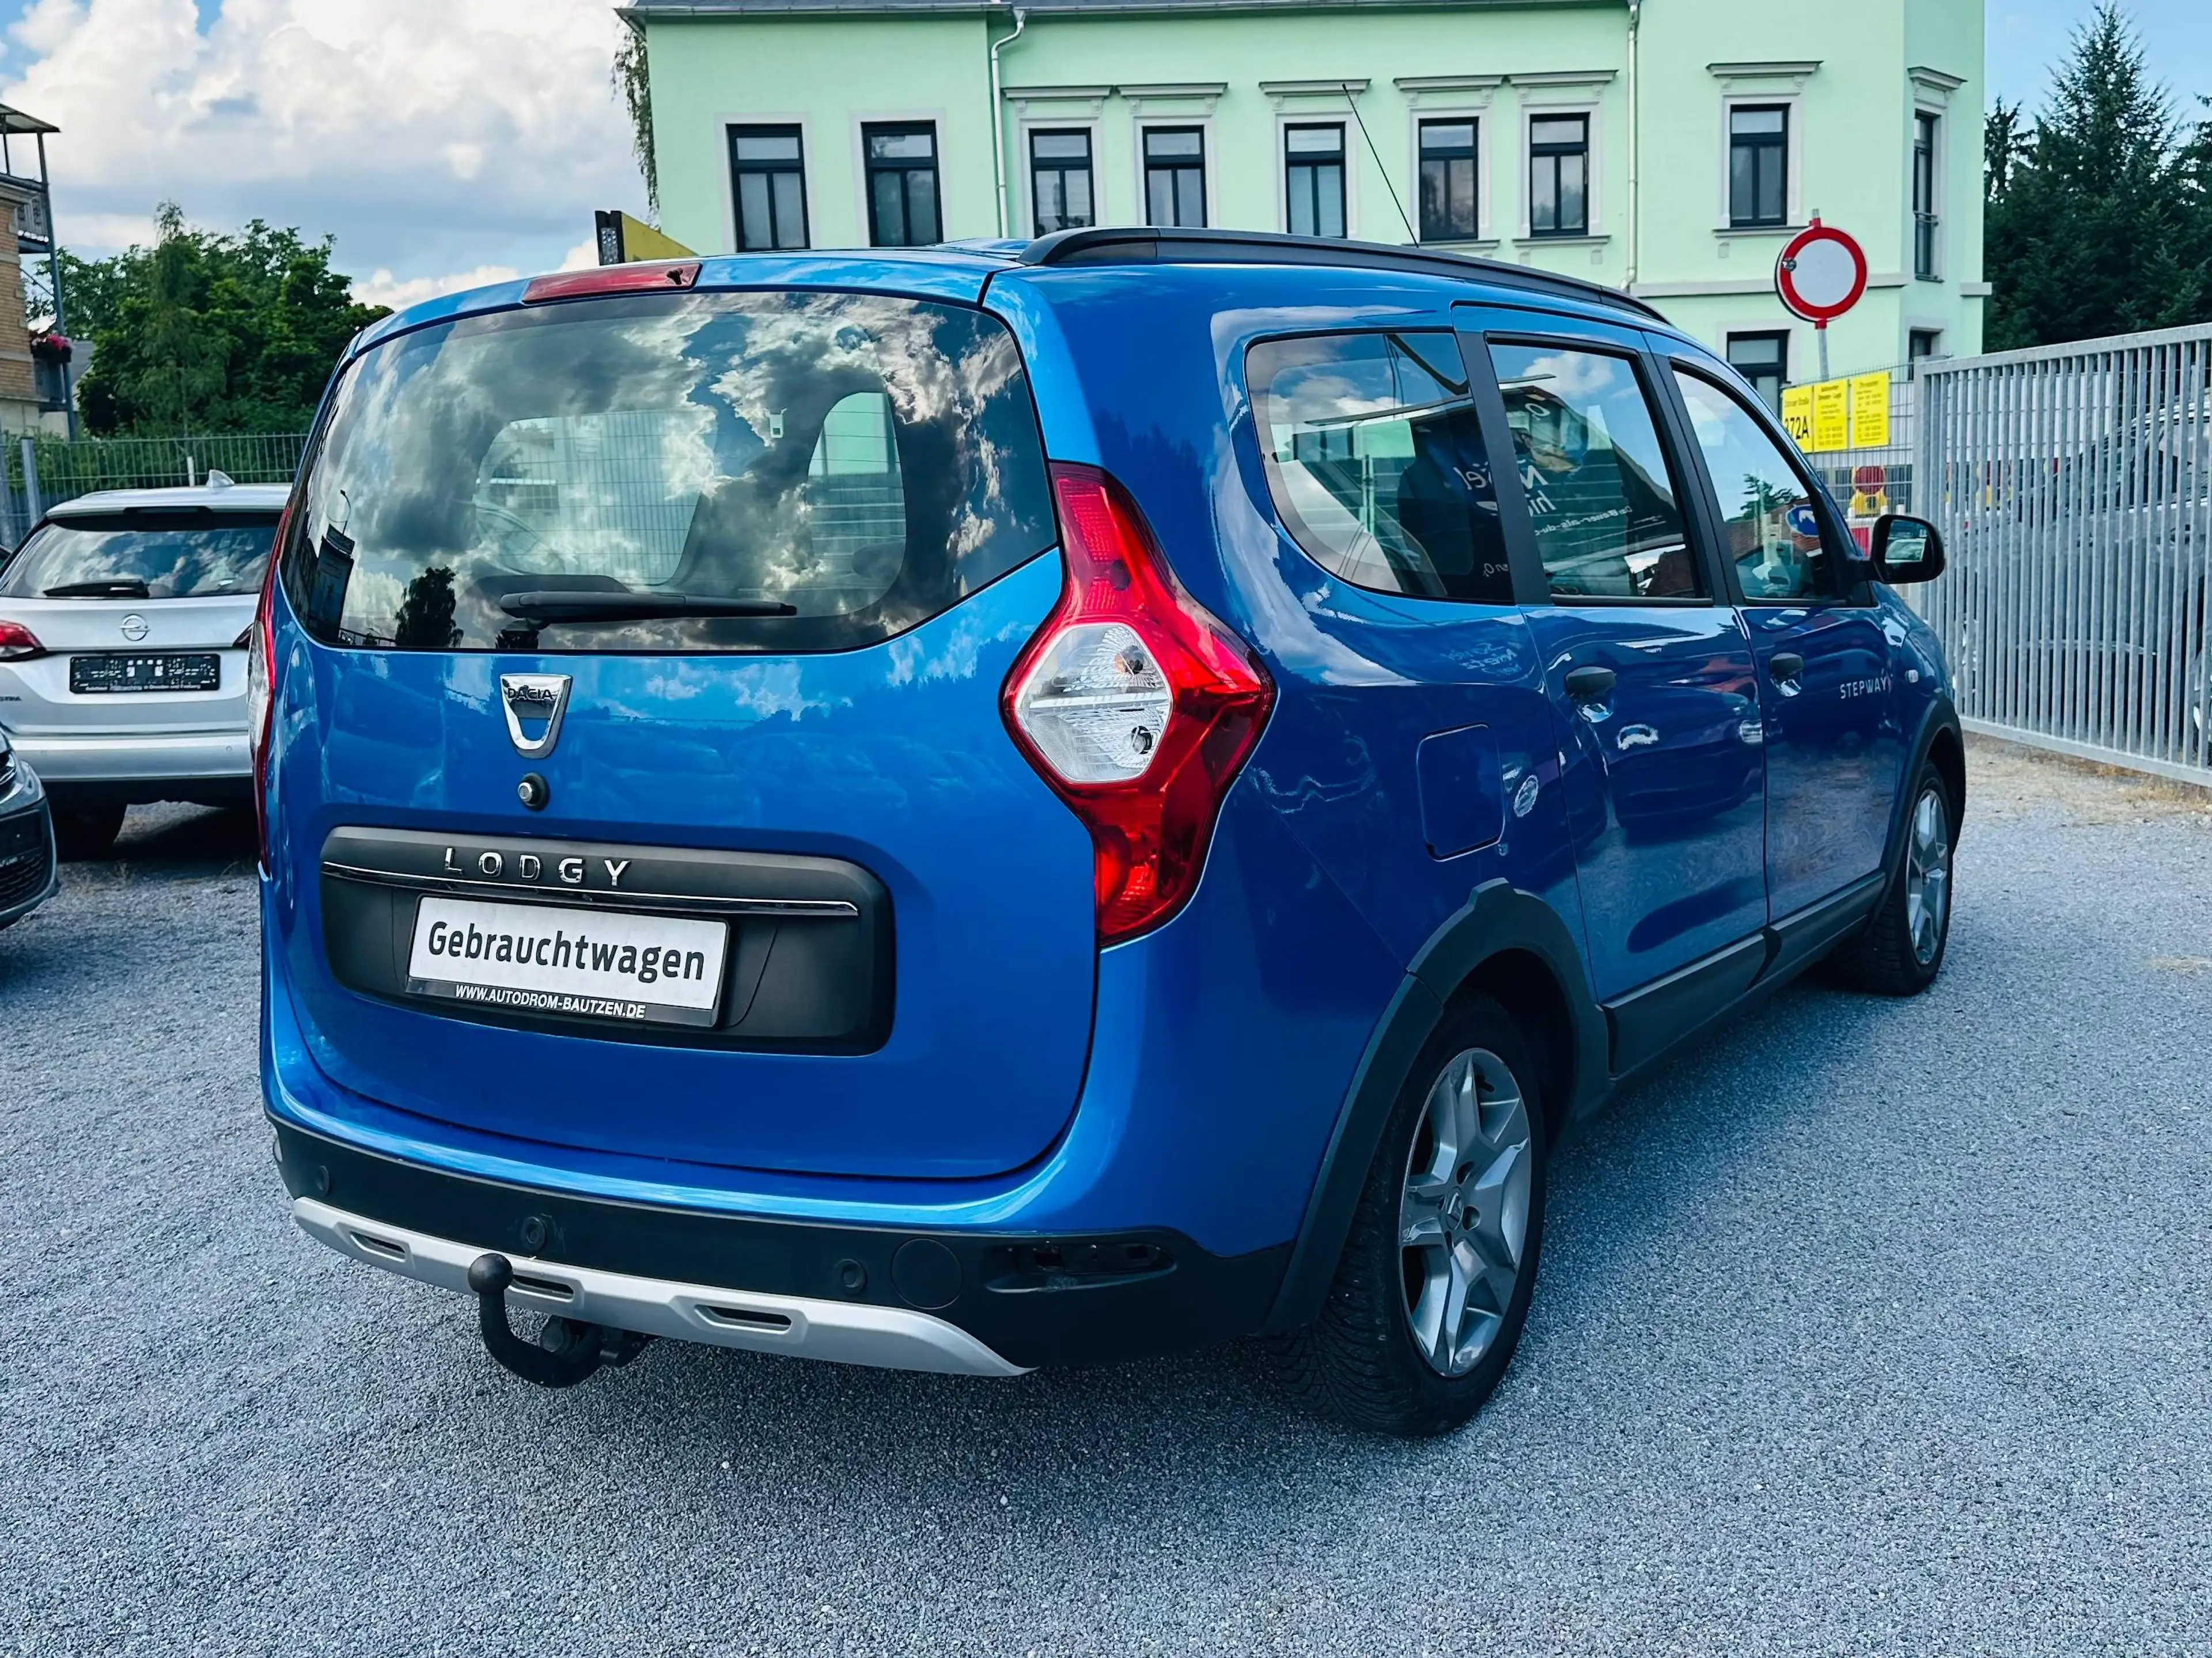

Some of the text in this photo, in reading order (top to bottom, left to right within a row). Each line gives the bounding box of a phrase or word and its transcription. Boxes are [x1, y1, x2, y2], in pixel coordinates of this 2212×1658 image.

[507, 688, 553, 700] DACIA
[1840, 677, 1887, 699] STEPWAY
[445, 847, 630, 886] LODGY
[429, 921, 704, 984] Gebrauchtwagen
[455, 984, 646, 1019] WWW.AUTODROM-BAUTZEN.DE
